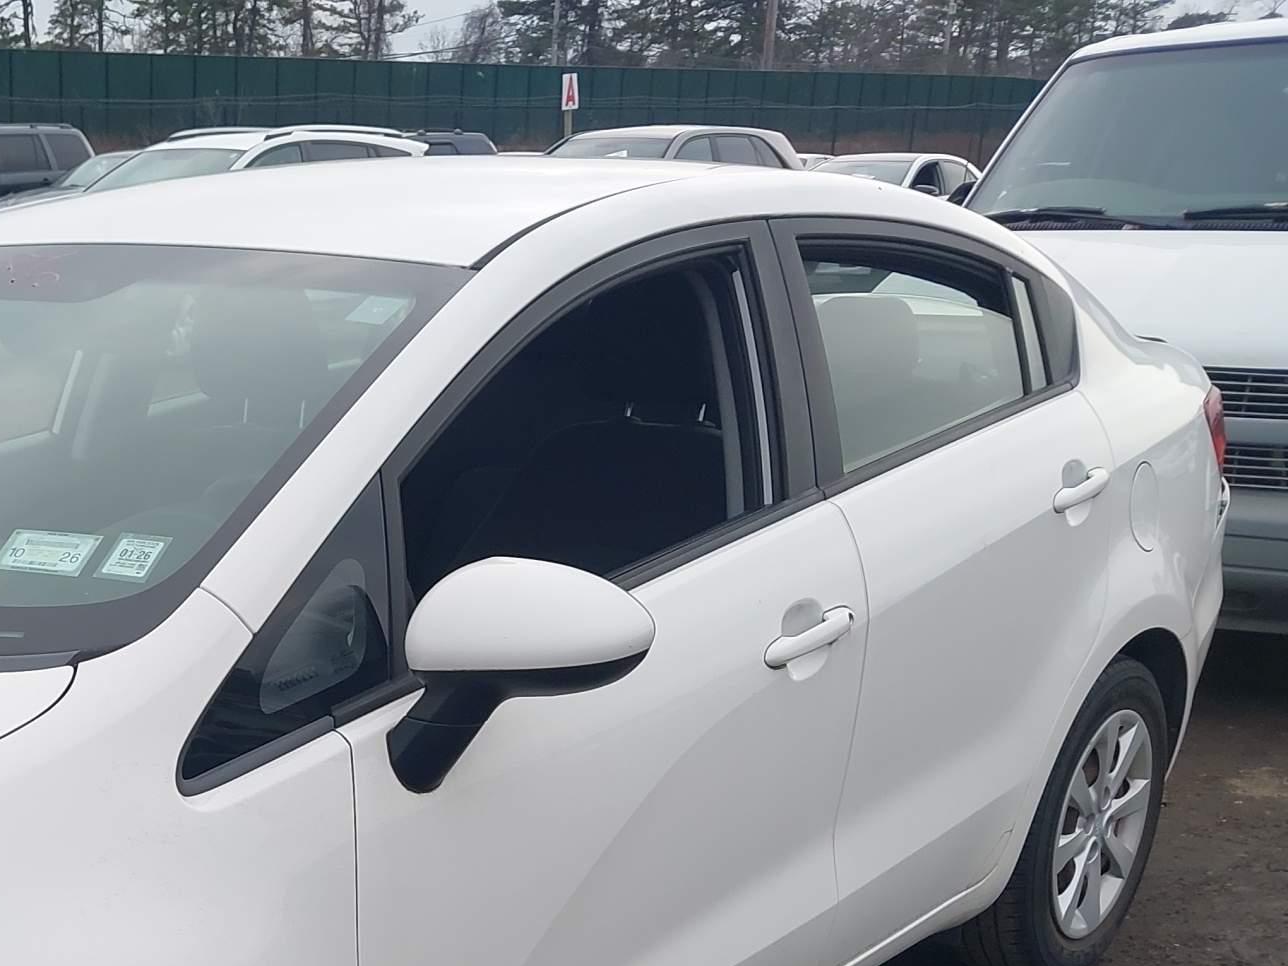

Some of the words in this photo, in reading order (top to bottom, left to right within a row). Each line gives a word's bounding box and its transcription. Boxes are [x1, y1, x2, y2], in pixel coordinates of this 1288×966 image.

[565, 74, 576, 107] A
[8, 547, 25, 558] 10
[58, 551, 81, 564] 26
